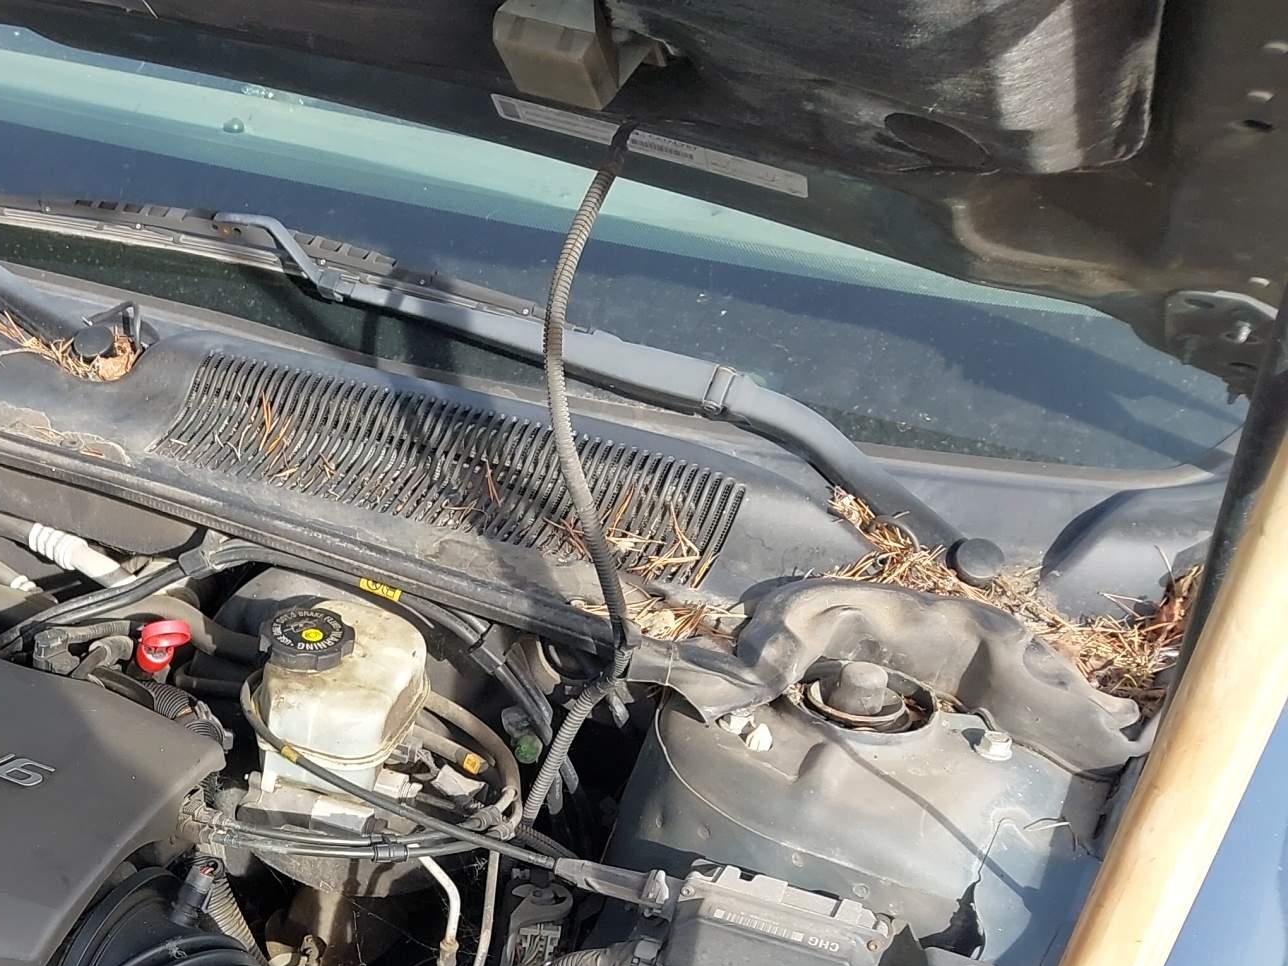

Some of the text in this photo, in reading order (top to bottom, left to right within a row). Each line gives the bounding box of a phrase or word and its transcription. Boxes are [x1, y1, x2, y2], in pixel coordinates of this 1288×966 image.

[297, 610, 324, 618] BRAKE
[297, 631, 343, 650] WARNING
[807, 936, 840, 952] CHG
